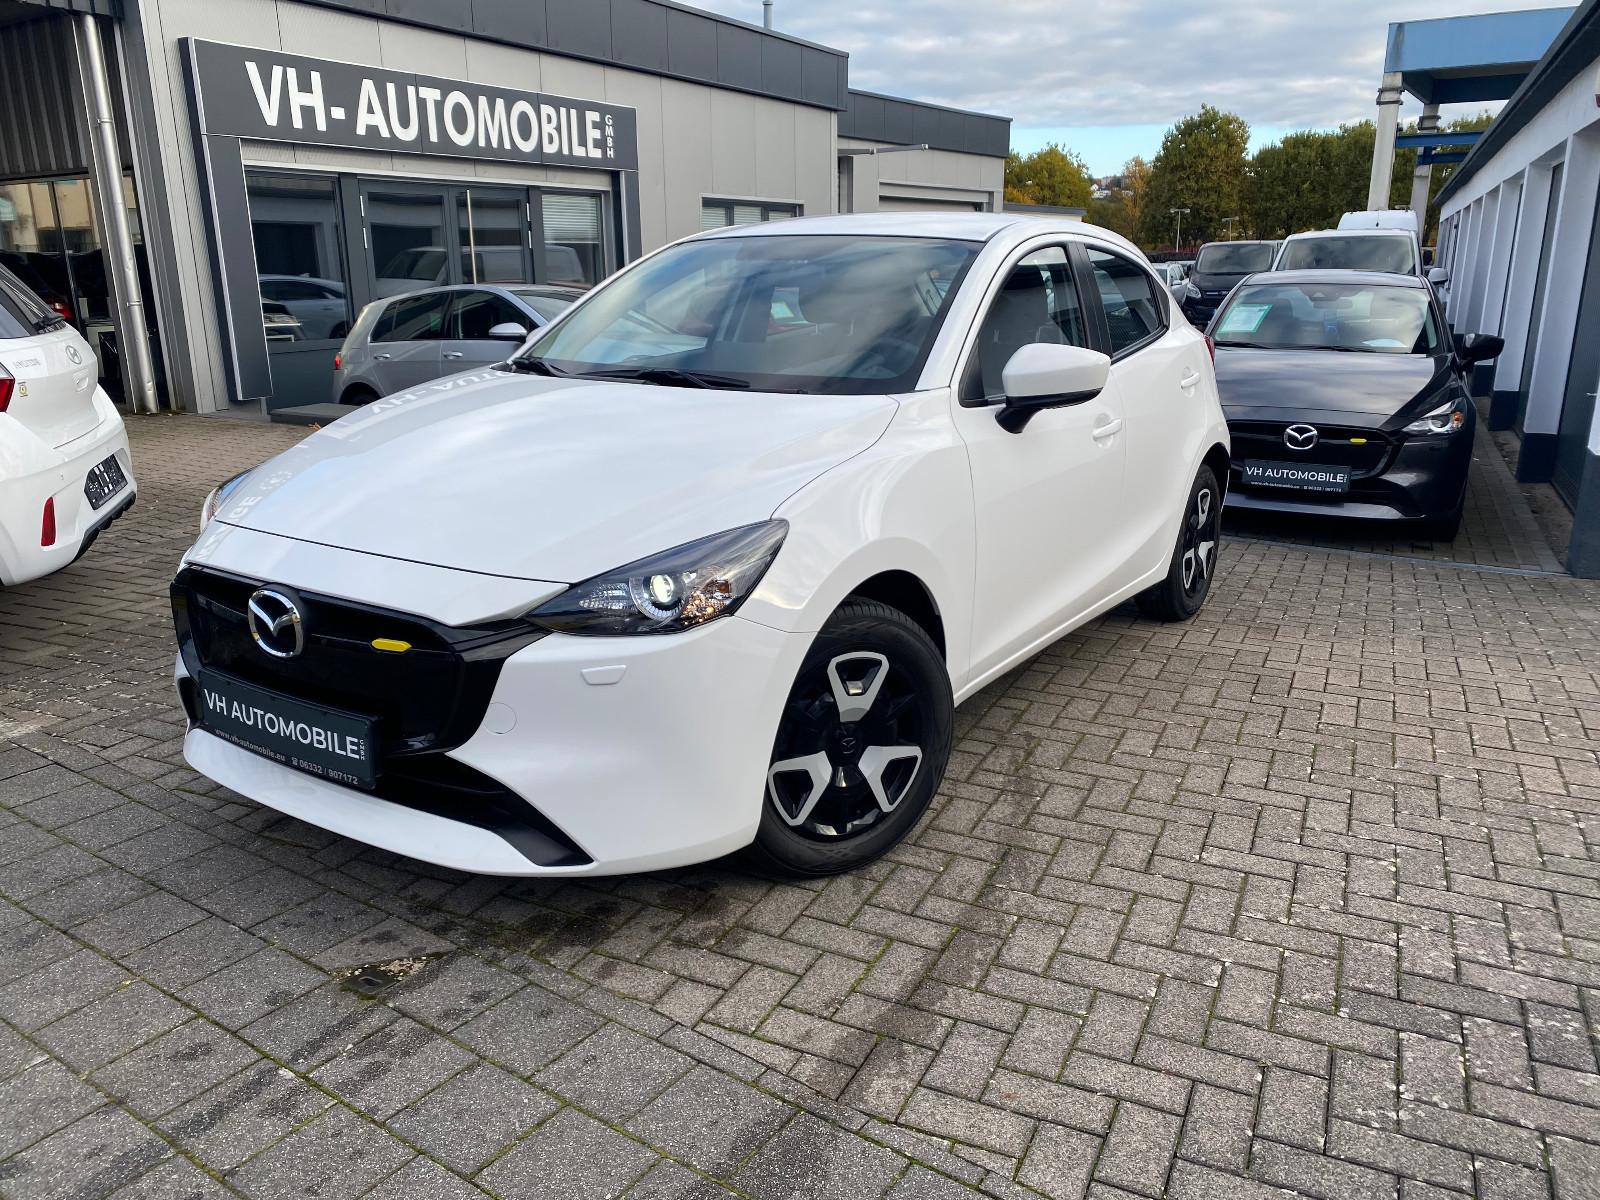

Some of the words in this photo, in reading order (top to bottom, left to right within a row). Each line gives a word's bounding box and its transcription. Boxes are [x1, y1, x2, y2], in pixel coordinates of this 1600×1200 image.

[356, 78, 602, 158] AUTOMOBILE
[605, 114, 614, 158] GMBH
[1246, 466, 1263, 476] VH
[1265, 468, 1344, 483] AUTOMOBILE
[204, 688, 227, 716] VH
[231, 701, 360, 760] AUTOMOBILE
[300, 759, 323, 774] 06332
[328, 768, 359, 785] 907172
